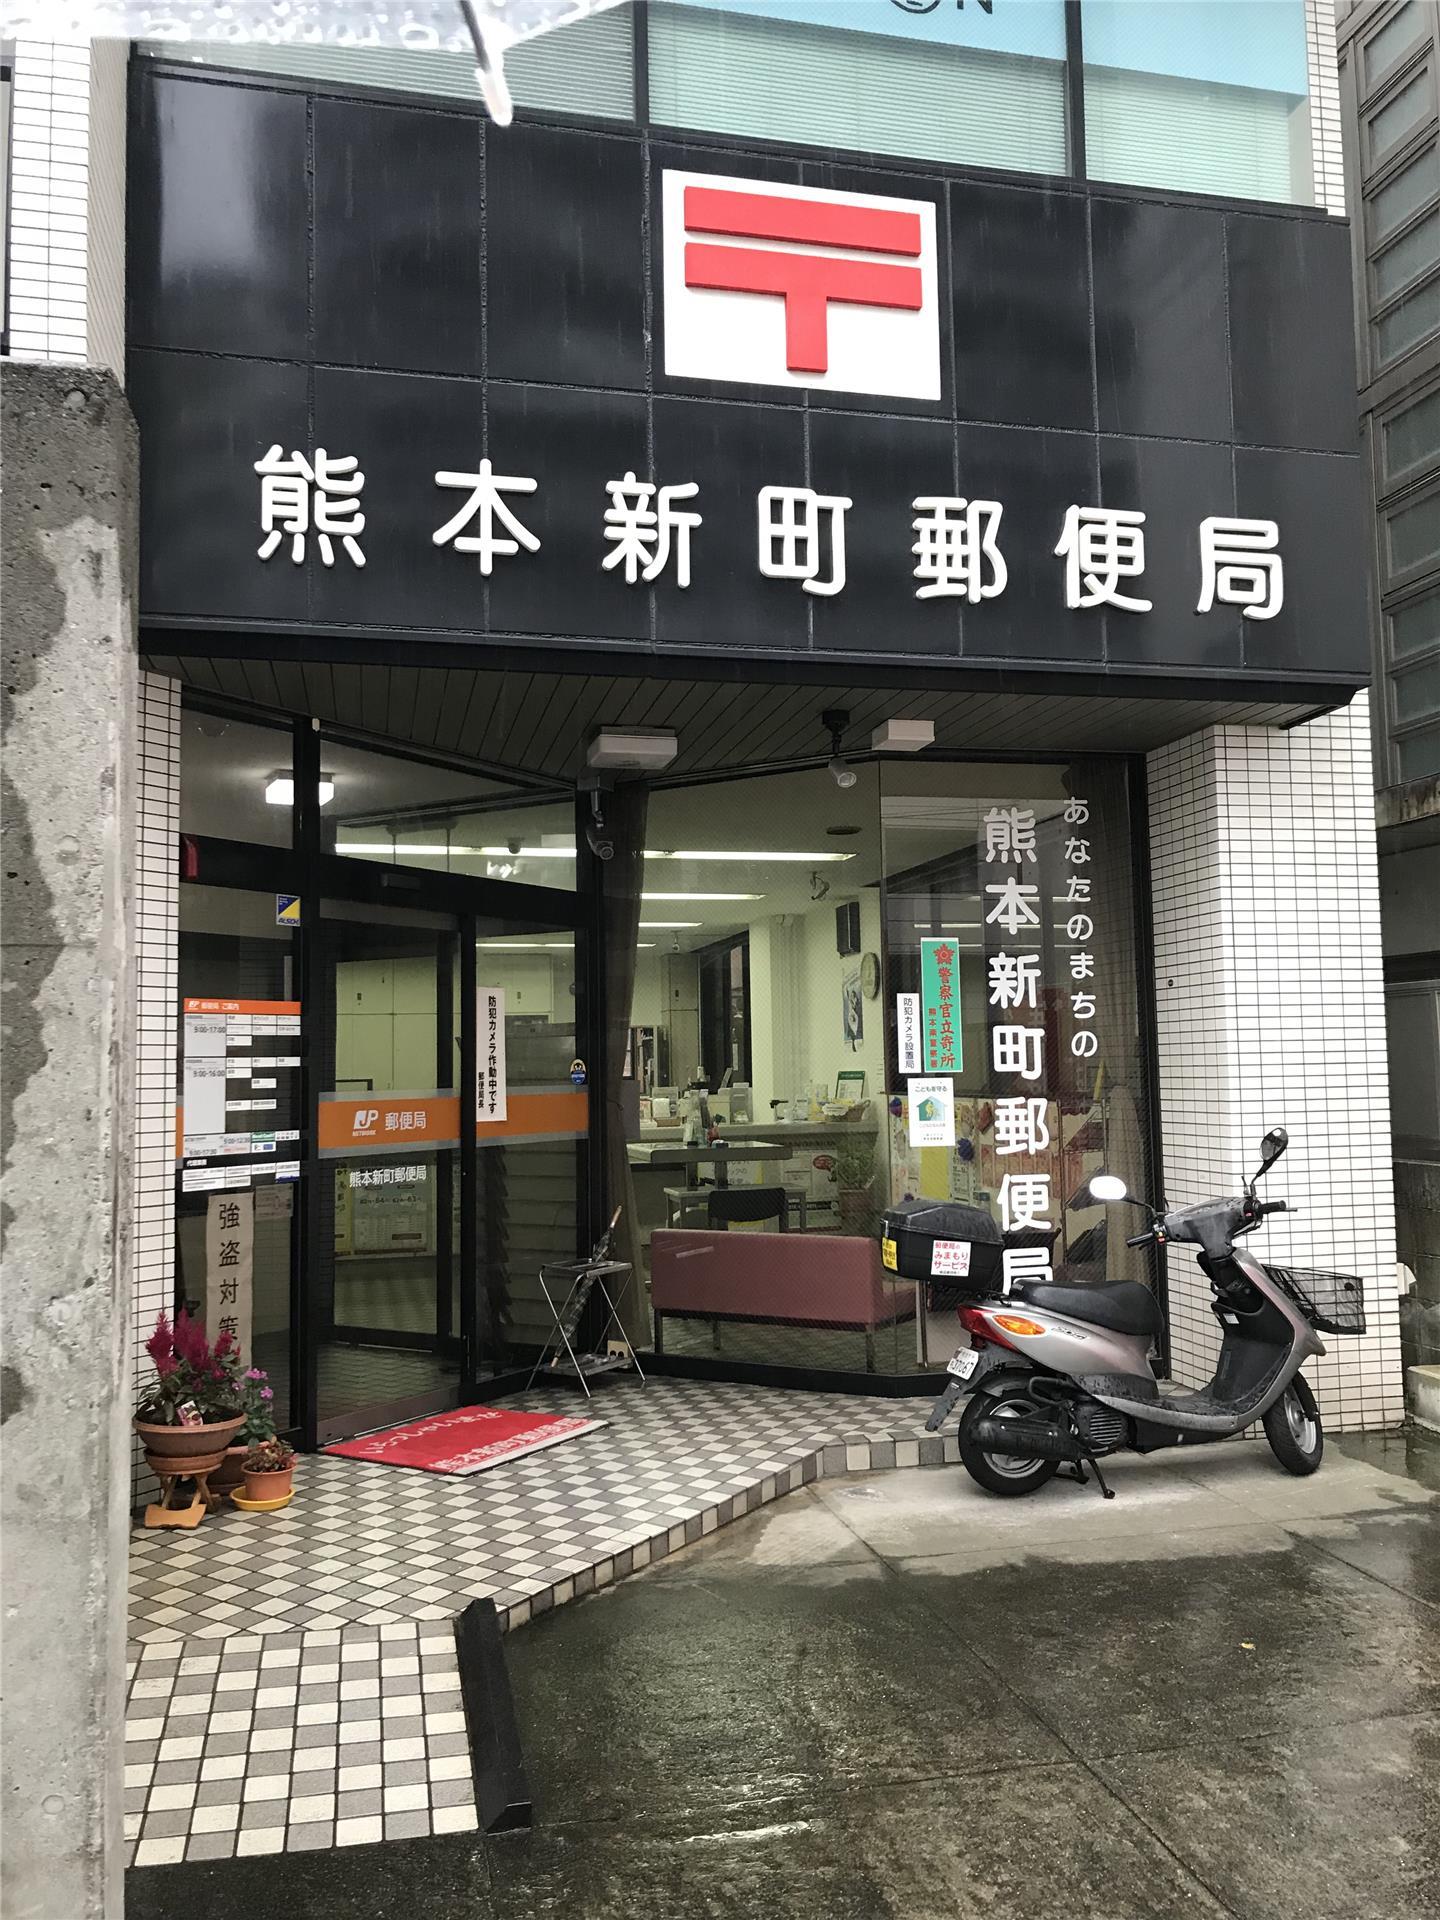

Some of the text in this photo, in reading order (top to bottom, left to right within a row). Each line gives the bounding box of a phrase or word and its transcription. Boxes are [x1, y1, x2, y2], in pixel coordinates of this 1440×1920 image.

[254, 444, 1284, 621] 熊本新町郵便局
[1063, 796, 1098, 1059] あなたのまちの
[903, 997, 915, 1069] 防犯カメラ設置局
[938, 967, 956, 1068] 警察官立寄所
[488, 995, 498, 1114] 防犯カメラ作動中です
[353, 1109, 427, 1131] JP 郵便局
[349, 1165, 427, 1188] 熊本新町郵便局
[933, 1251, 968, 1261] みまもり
[933, 1261, 968, 1270] サービス
